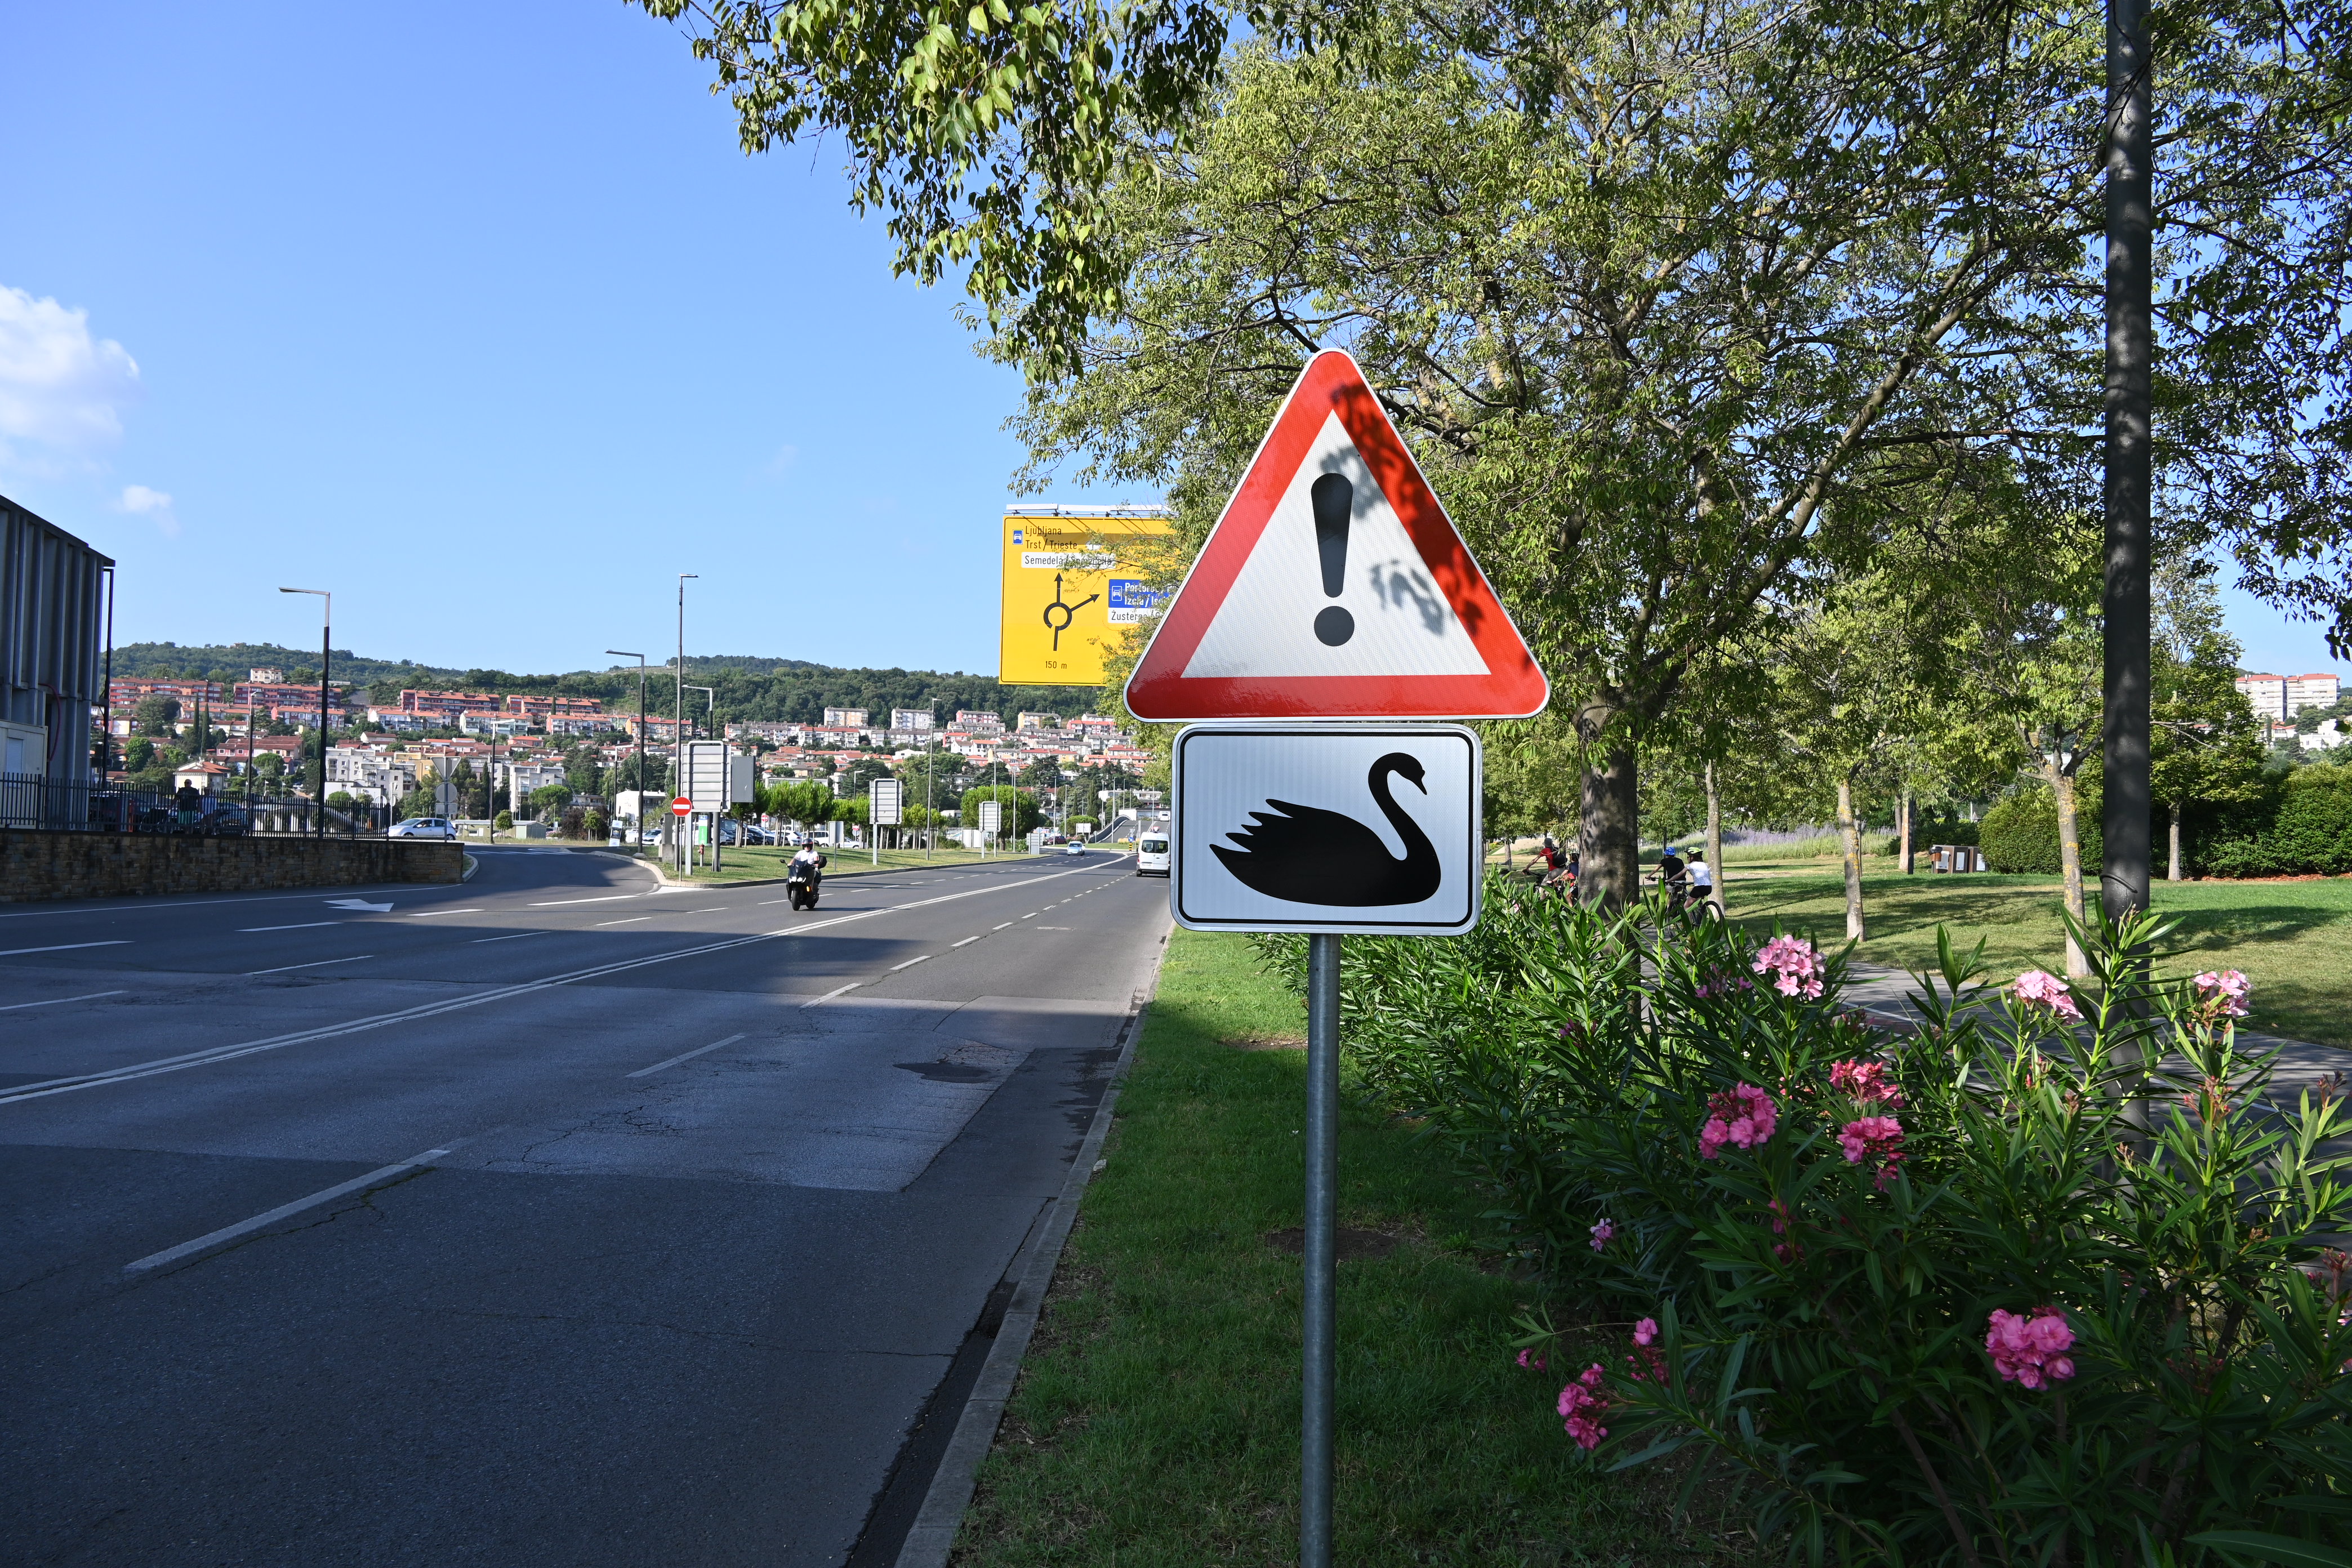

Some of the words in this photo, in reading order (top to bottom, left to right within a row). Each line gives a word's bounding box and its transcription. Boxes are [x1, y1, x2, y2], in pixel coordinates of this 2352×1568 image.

[1025, 525, 1062, 537] Ljubljana
[1025, 540, 1041, 549] Trst
[1049, 540, 1077, 550] Trieste
[1024, 555, 1063, 565] Semedela
